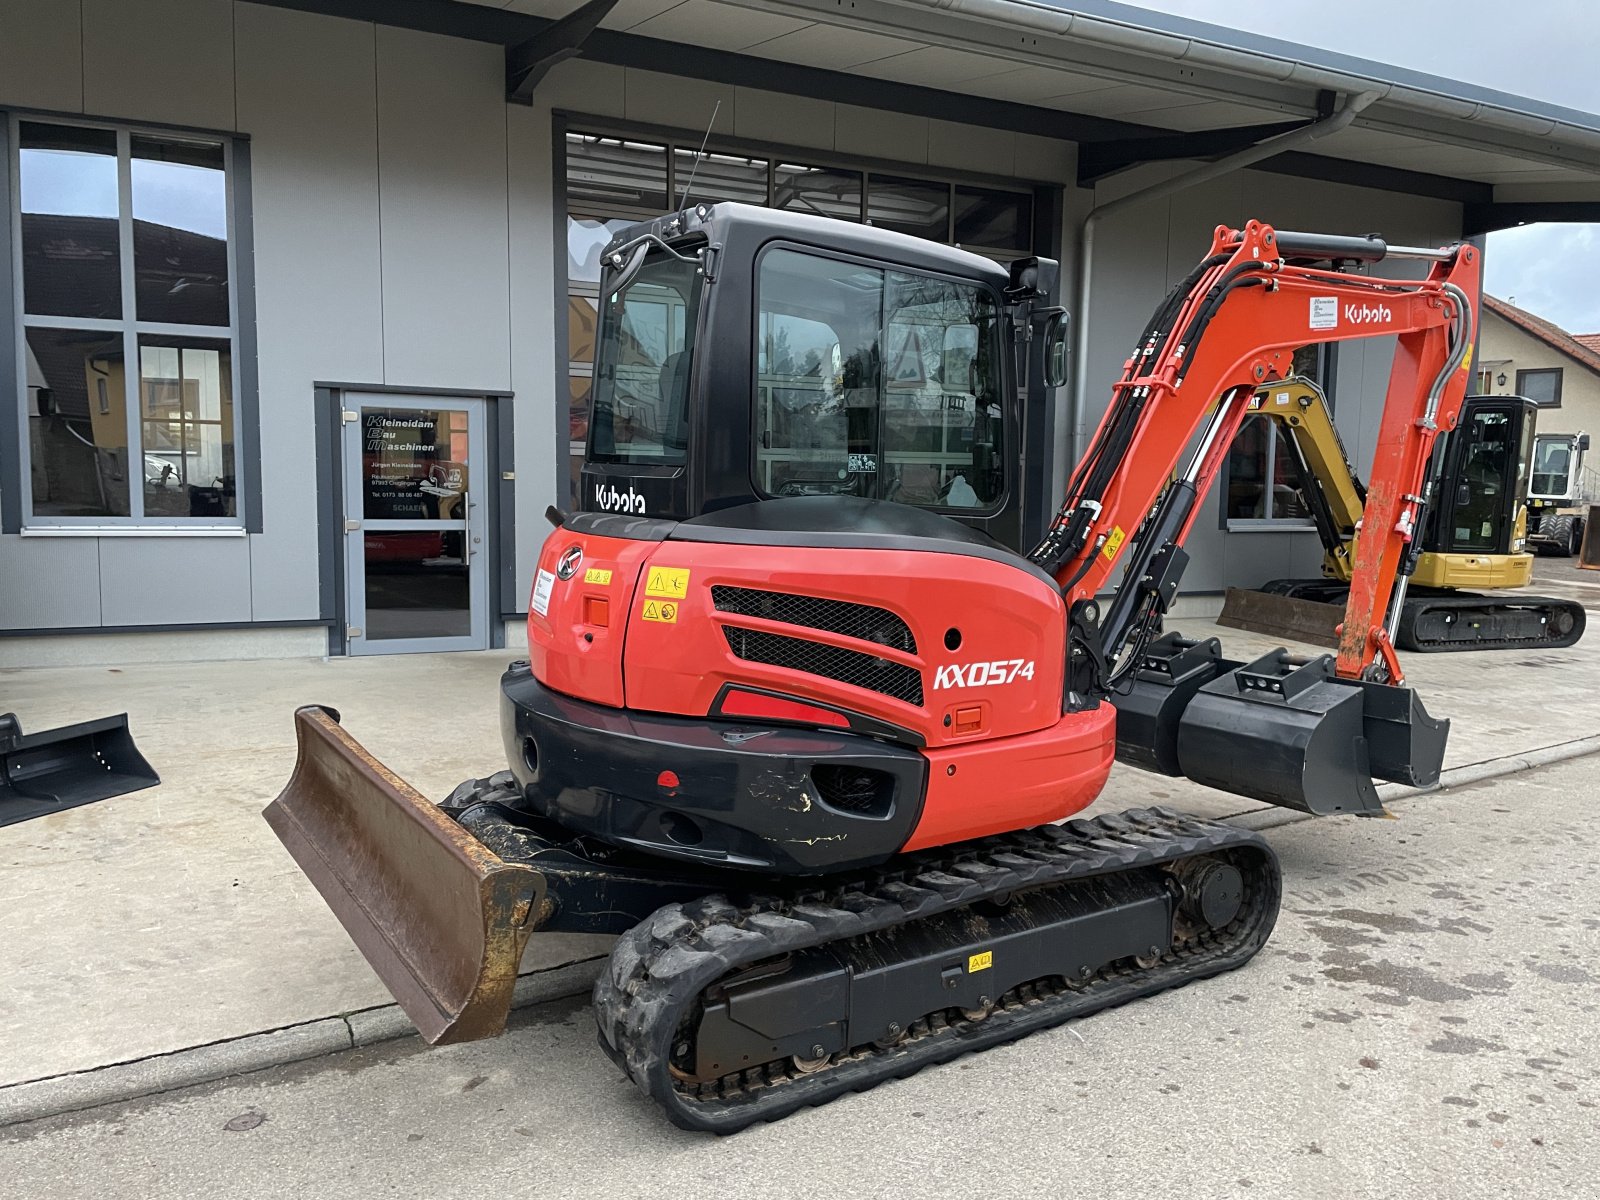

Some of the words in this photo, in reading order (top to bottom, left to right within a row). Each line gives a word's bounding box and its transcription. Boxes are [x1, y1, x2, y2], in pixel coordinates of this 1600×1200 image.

[1345, 304, 1391, 323] Kubota
[1247, 397, 1260, 409] AT
[367, 416, 434, 428] Kleineidam
[367, 428, 396, 438] Bau
[367, 440, 435, 451] Maschinen
[596, 484, 646, 513] Kubota
